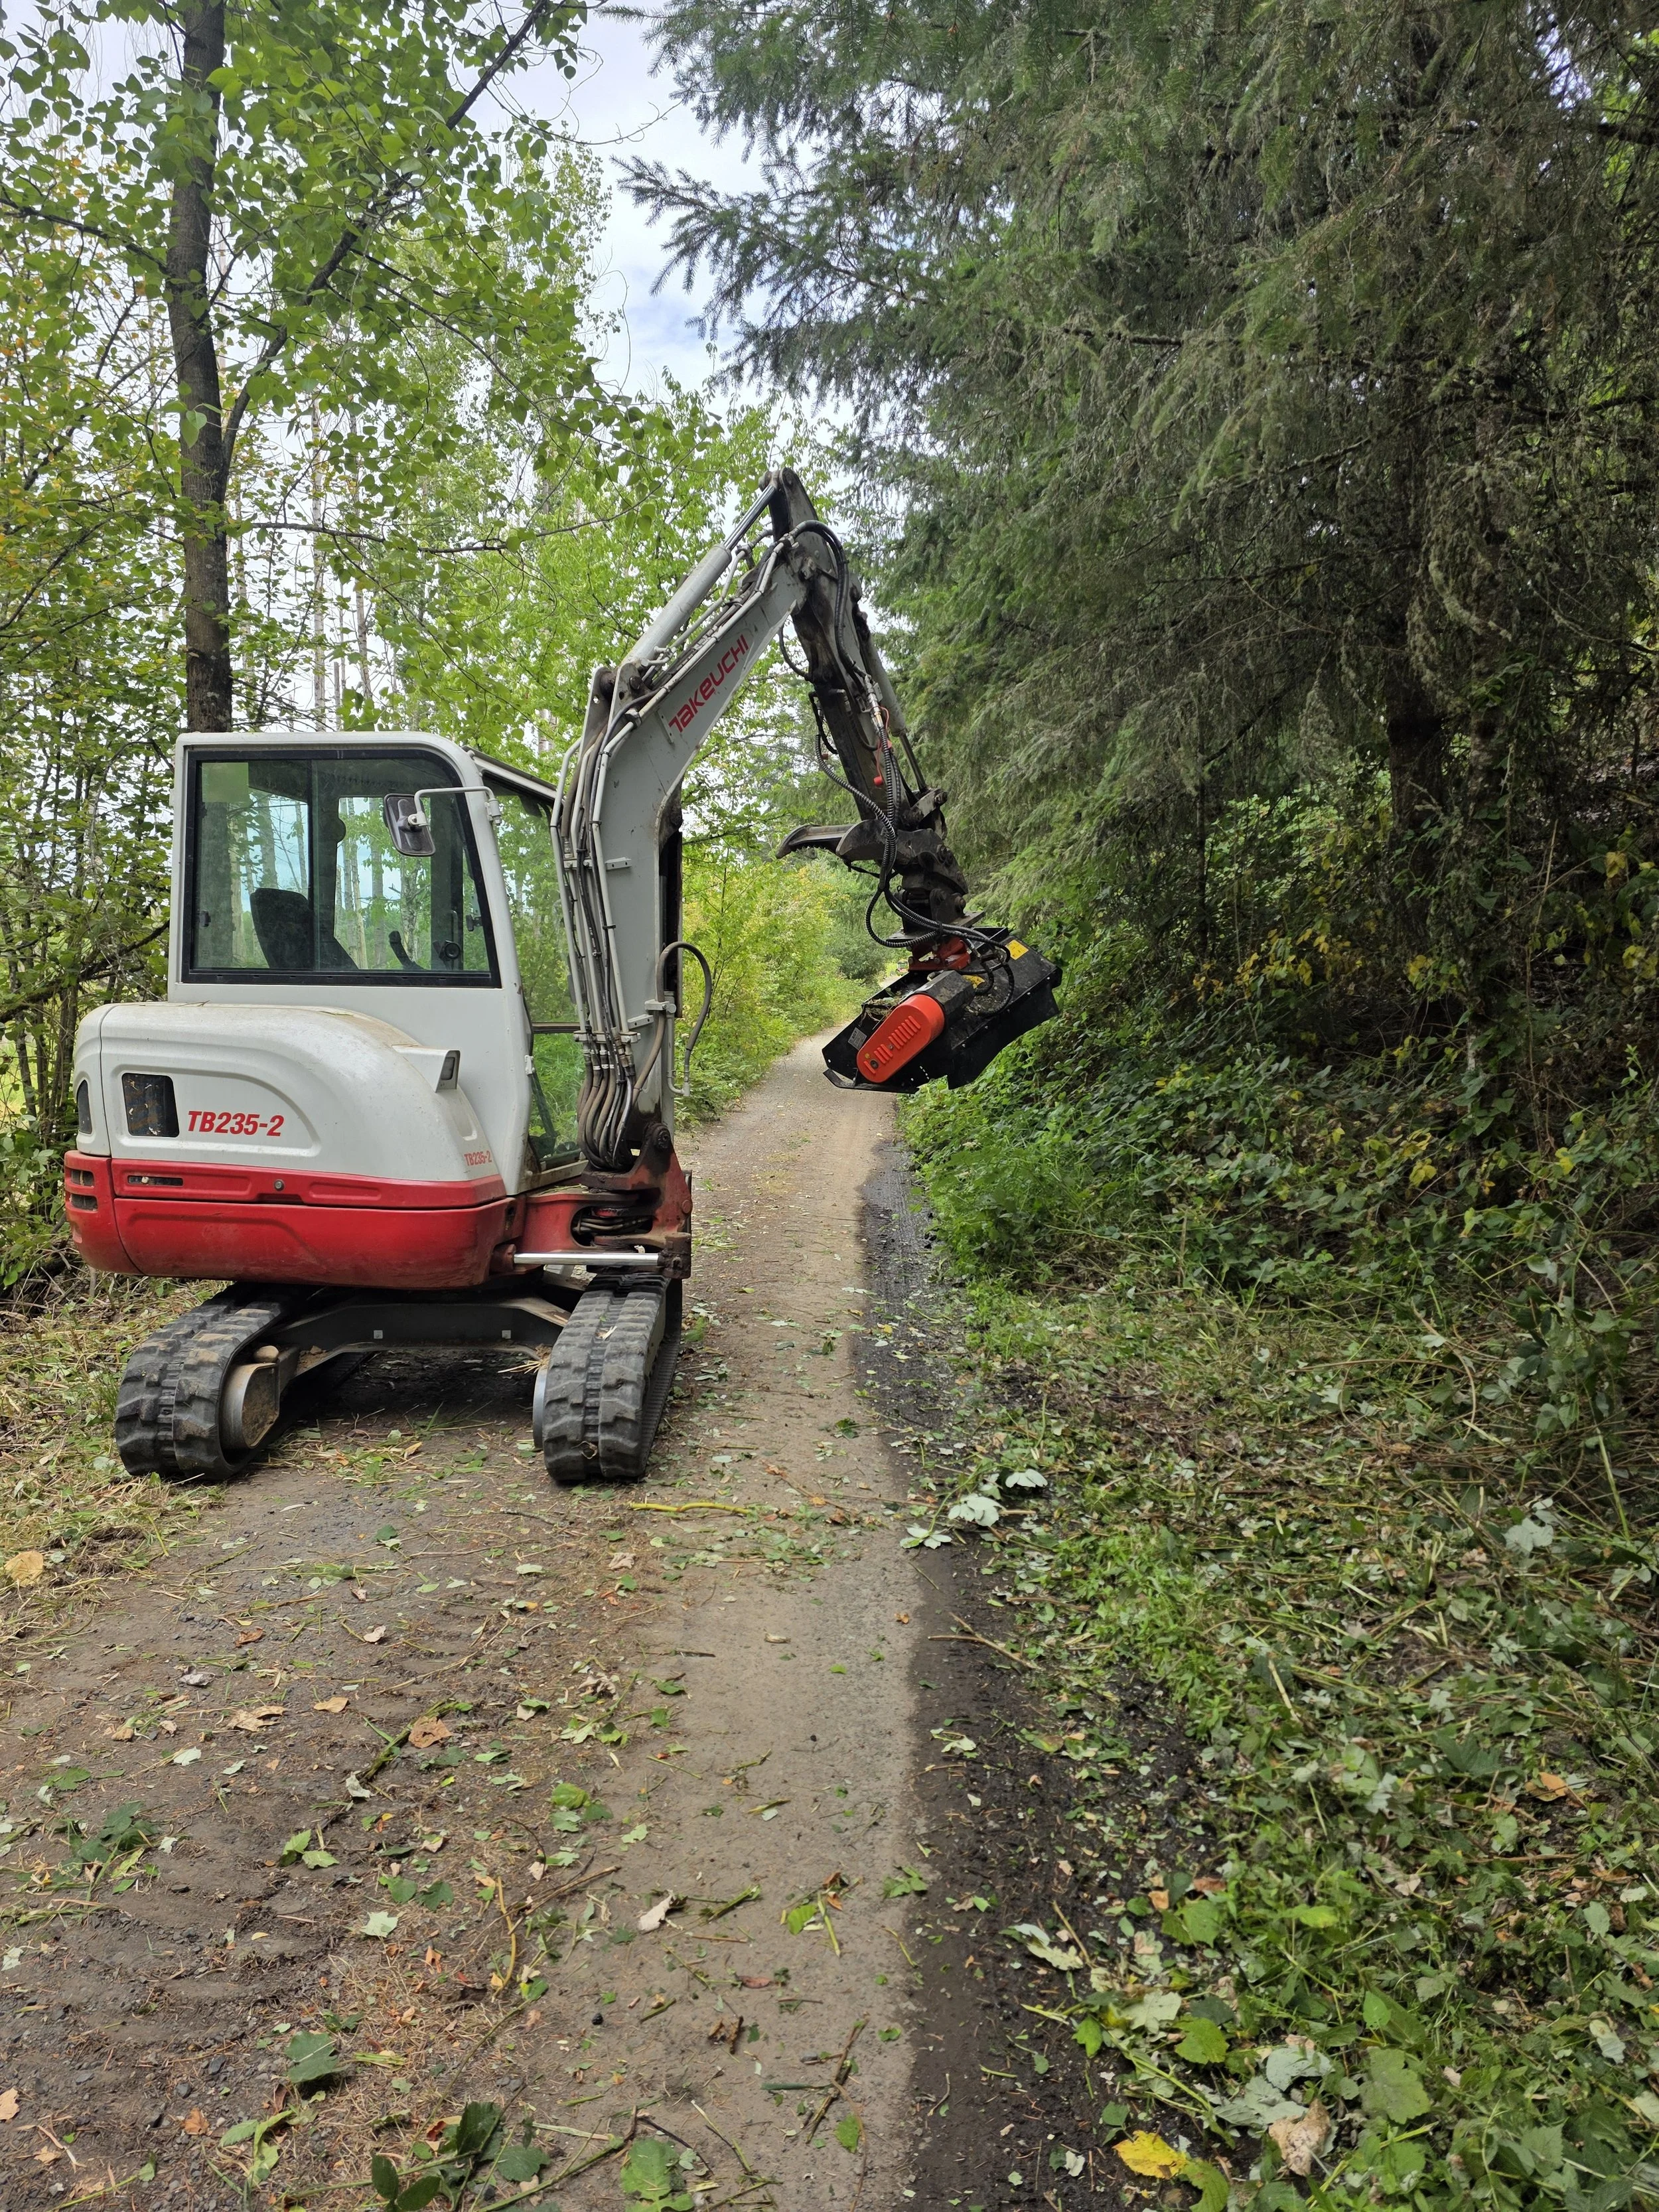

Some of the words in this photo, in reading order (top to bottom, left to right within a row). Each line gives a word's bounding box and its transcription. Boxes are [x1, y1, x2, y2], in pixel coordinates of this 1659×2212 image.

[668, 634, 749, 733] TAKEUCHI
[188, 1110, 284, 1136] TB235-2
[464, 1150, 492, 1166] TB235-2
